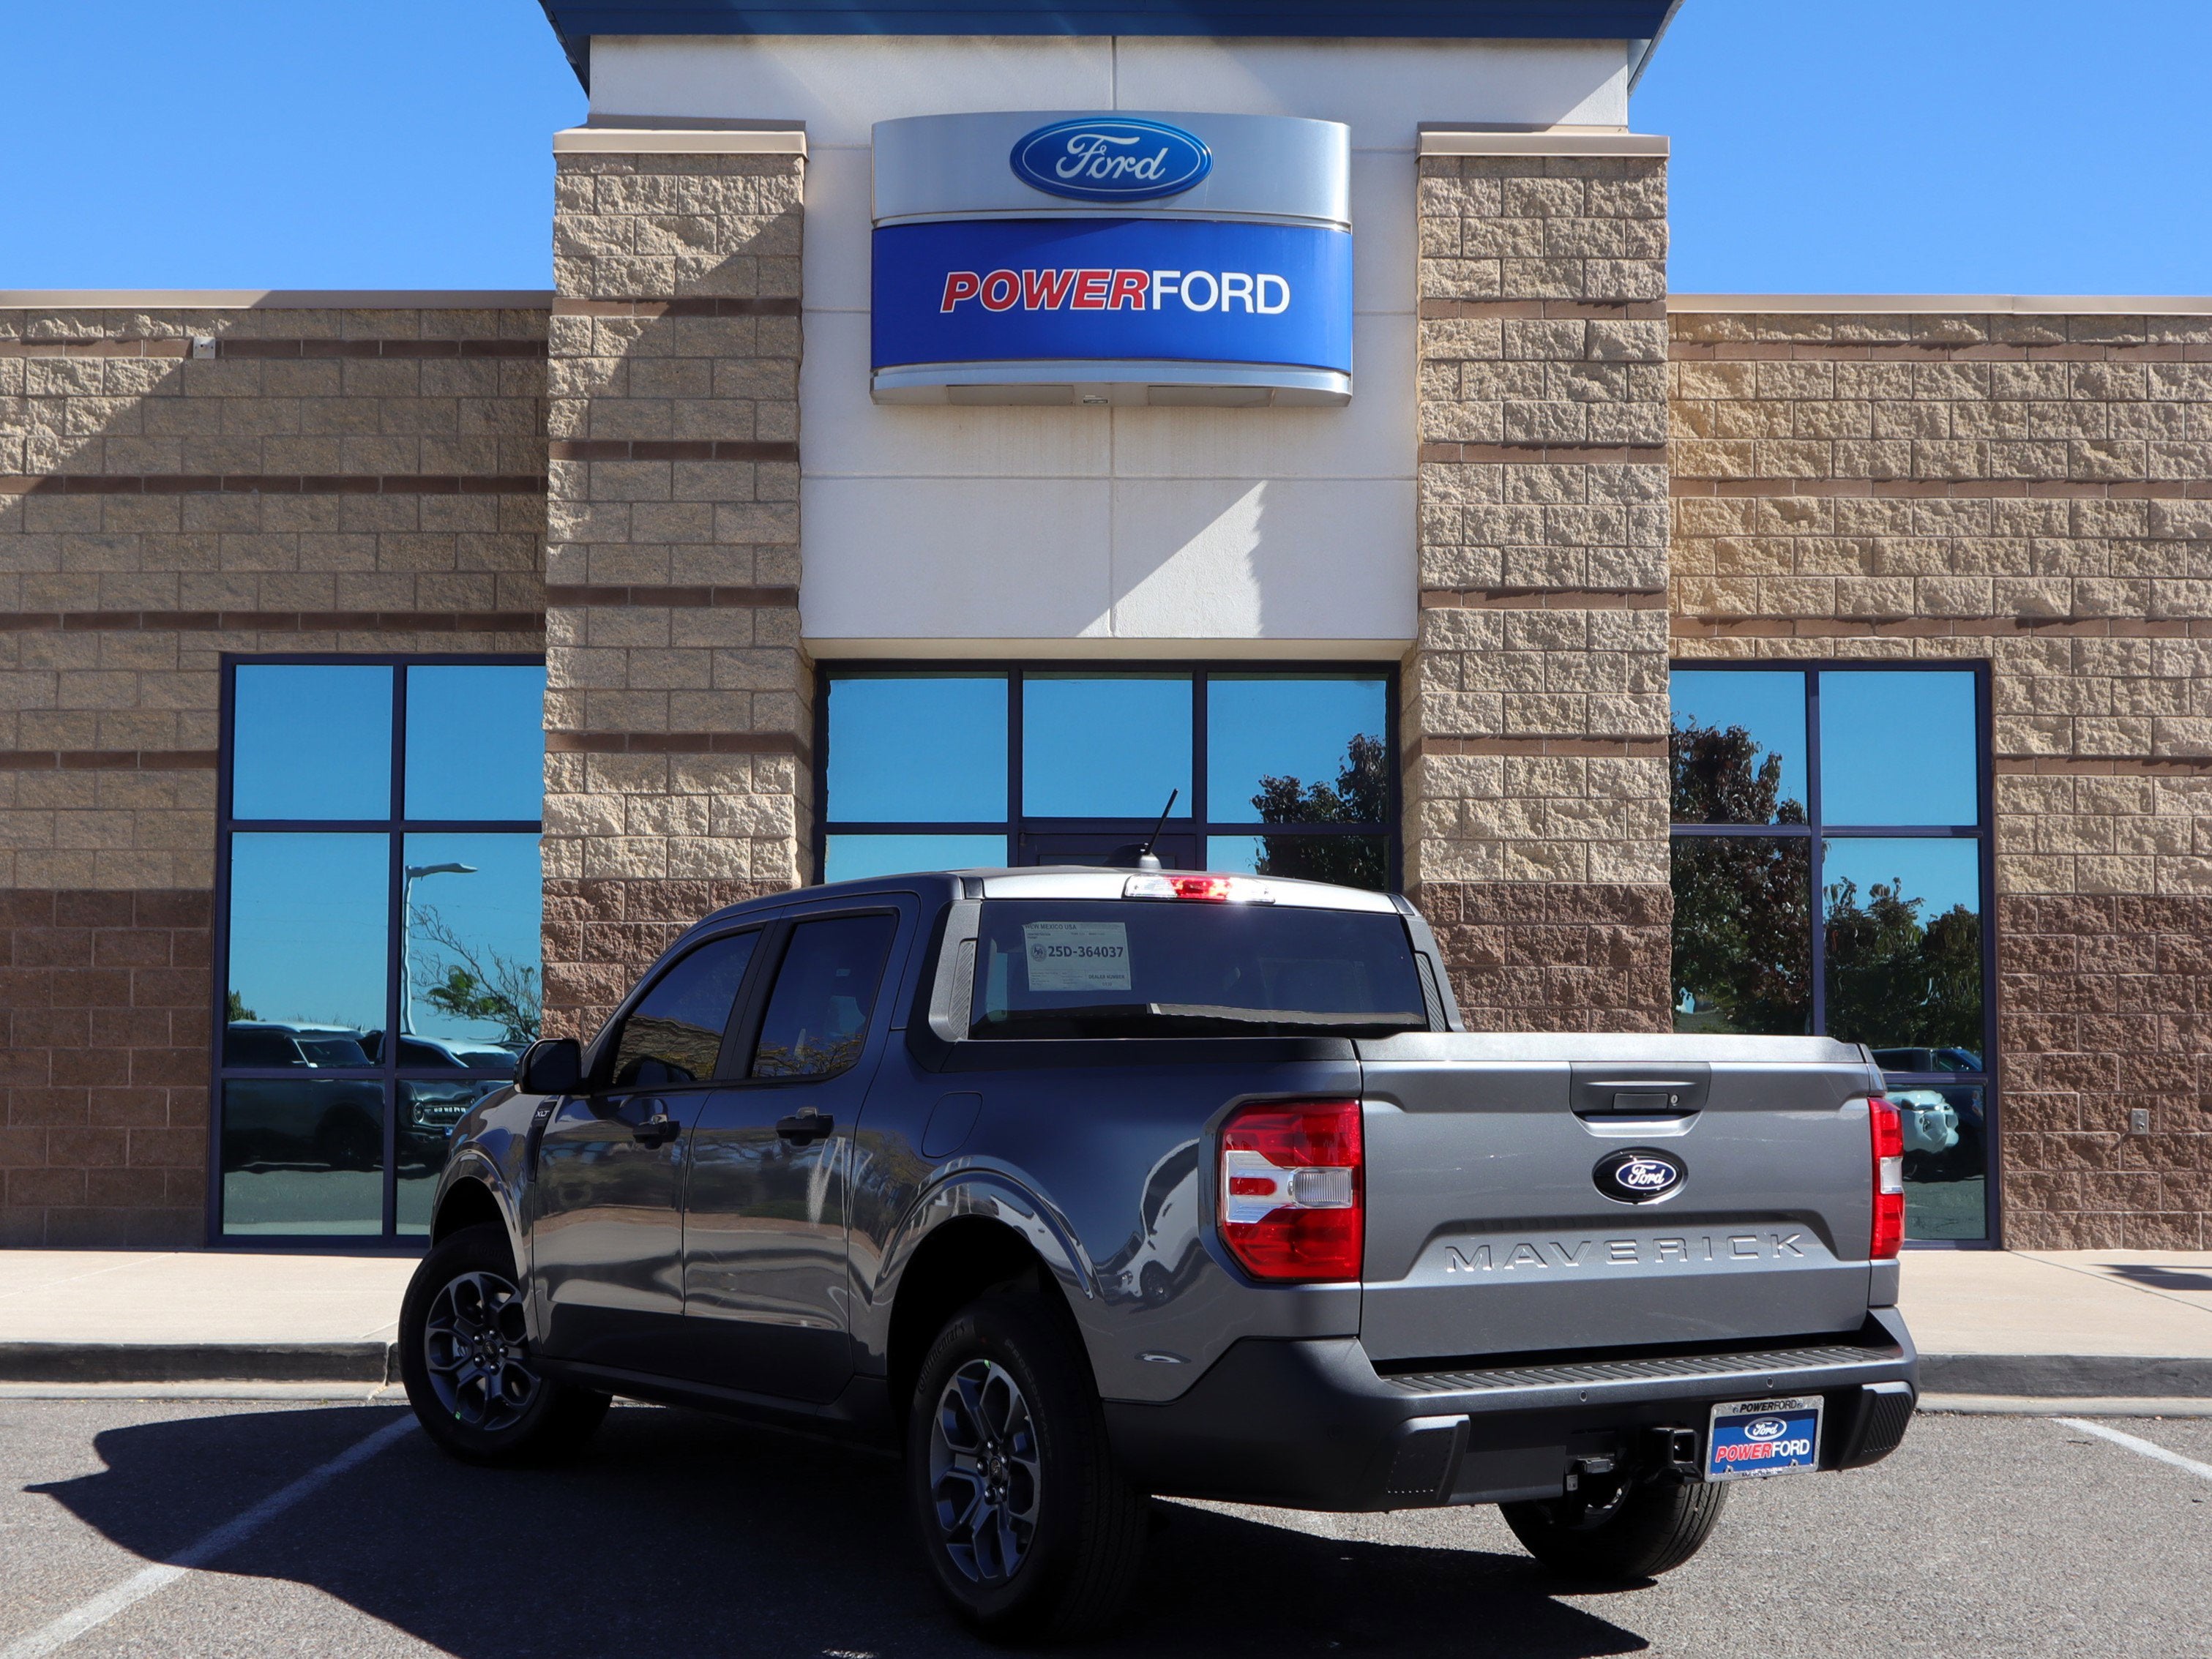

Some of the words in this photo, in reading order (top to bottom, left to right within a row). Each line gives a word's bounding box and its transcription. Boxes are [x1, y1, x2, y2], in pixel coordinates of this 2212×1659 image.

[1055, 133, 1169, 181] Ford
[940, 268, 1290, 315] POWERFORD
[1048, 945, 1124, 958] 25D-364037
[1628, 1164, 1665, 1185] Ford
[1445, 1232, 1806, 1273] MAVERICK
[1739, 1399, 1797, 1413] POWERFORD
[1752, 1422, 1779, 1436] Ford
[1715, 1439, 1810, 1463] POWERFORD
